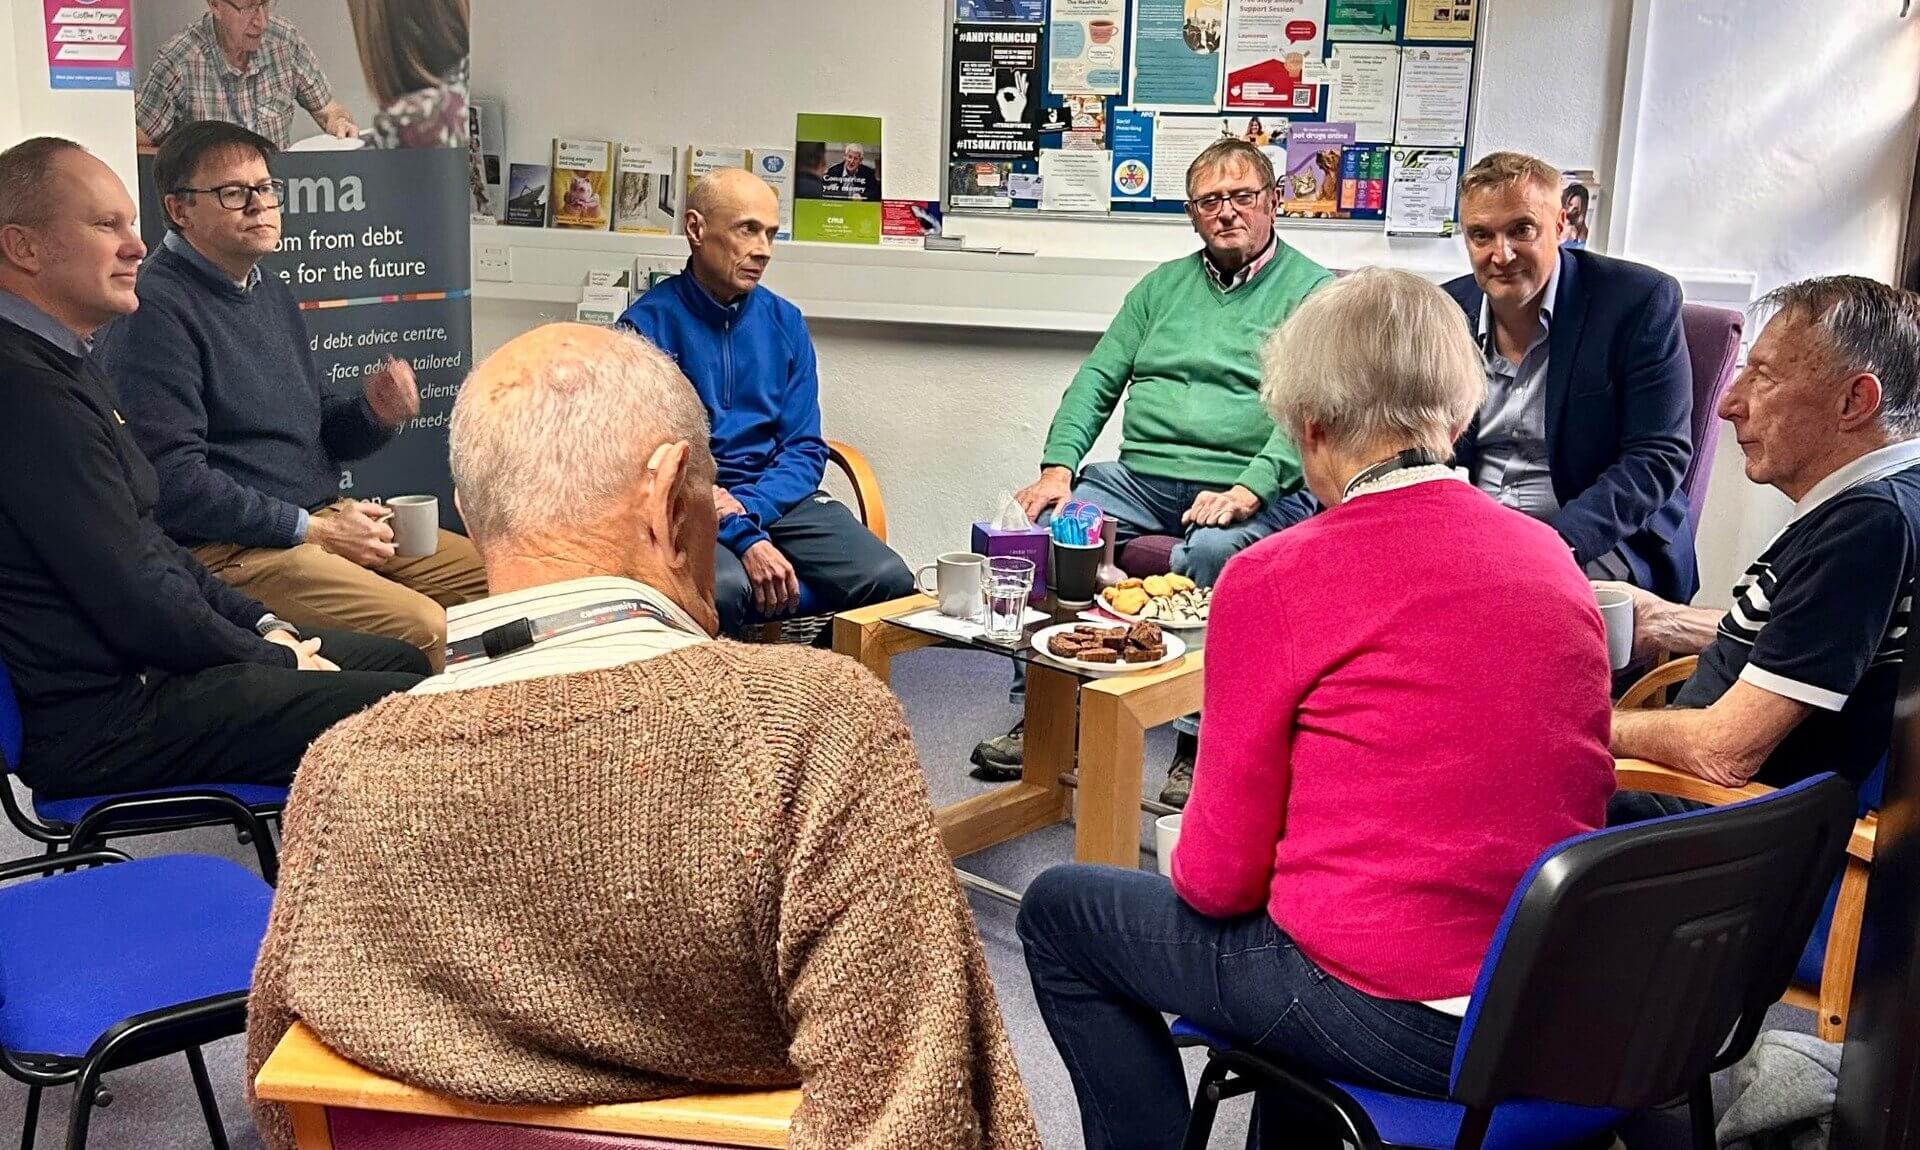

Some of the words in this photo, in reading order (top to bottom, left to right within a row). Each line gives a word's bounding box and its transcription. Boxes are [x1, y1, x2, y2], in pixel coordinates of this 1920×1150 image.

[960, 32, 1038, 43] #ANDYSMANCLUB
[956, 140, 1034, 151] #ITSOKAYTOTALK
[822, 175, 866, 185] Conquering
[822, 183, 839, 192] your
[841, 186, 866, 194] money
[308, 229, 355, 251] from
[361, 225, 404, 247] debt
[297, 262, 327, 284] for
[333, 261, 363, 281] the
[369, 258, 426, 278] future
[323, 332, 353, 350] debt
[357, 328, 399, 346] advice
[403, 326, 448, 343] centre,
[413, 350, 461, 370] tailored
[420, 382, 460, 399] clients
[579, 601, 637, 619] community
